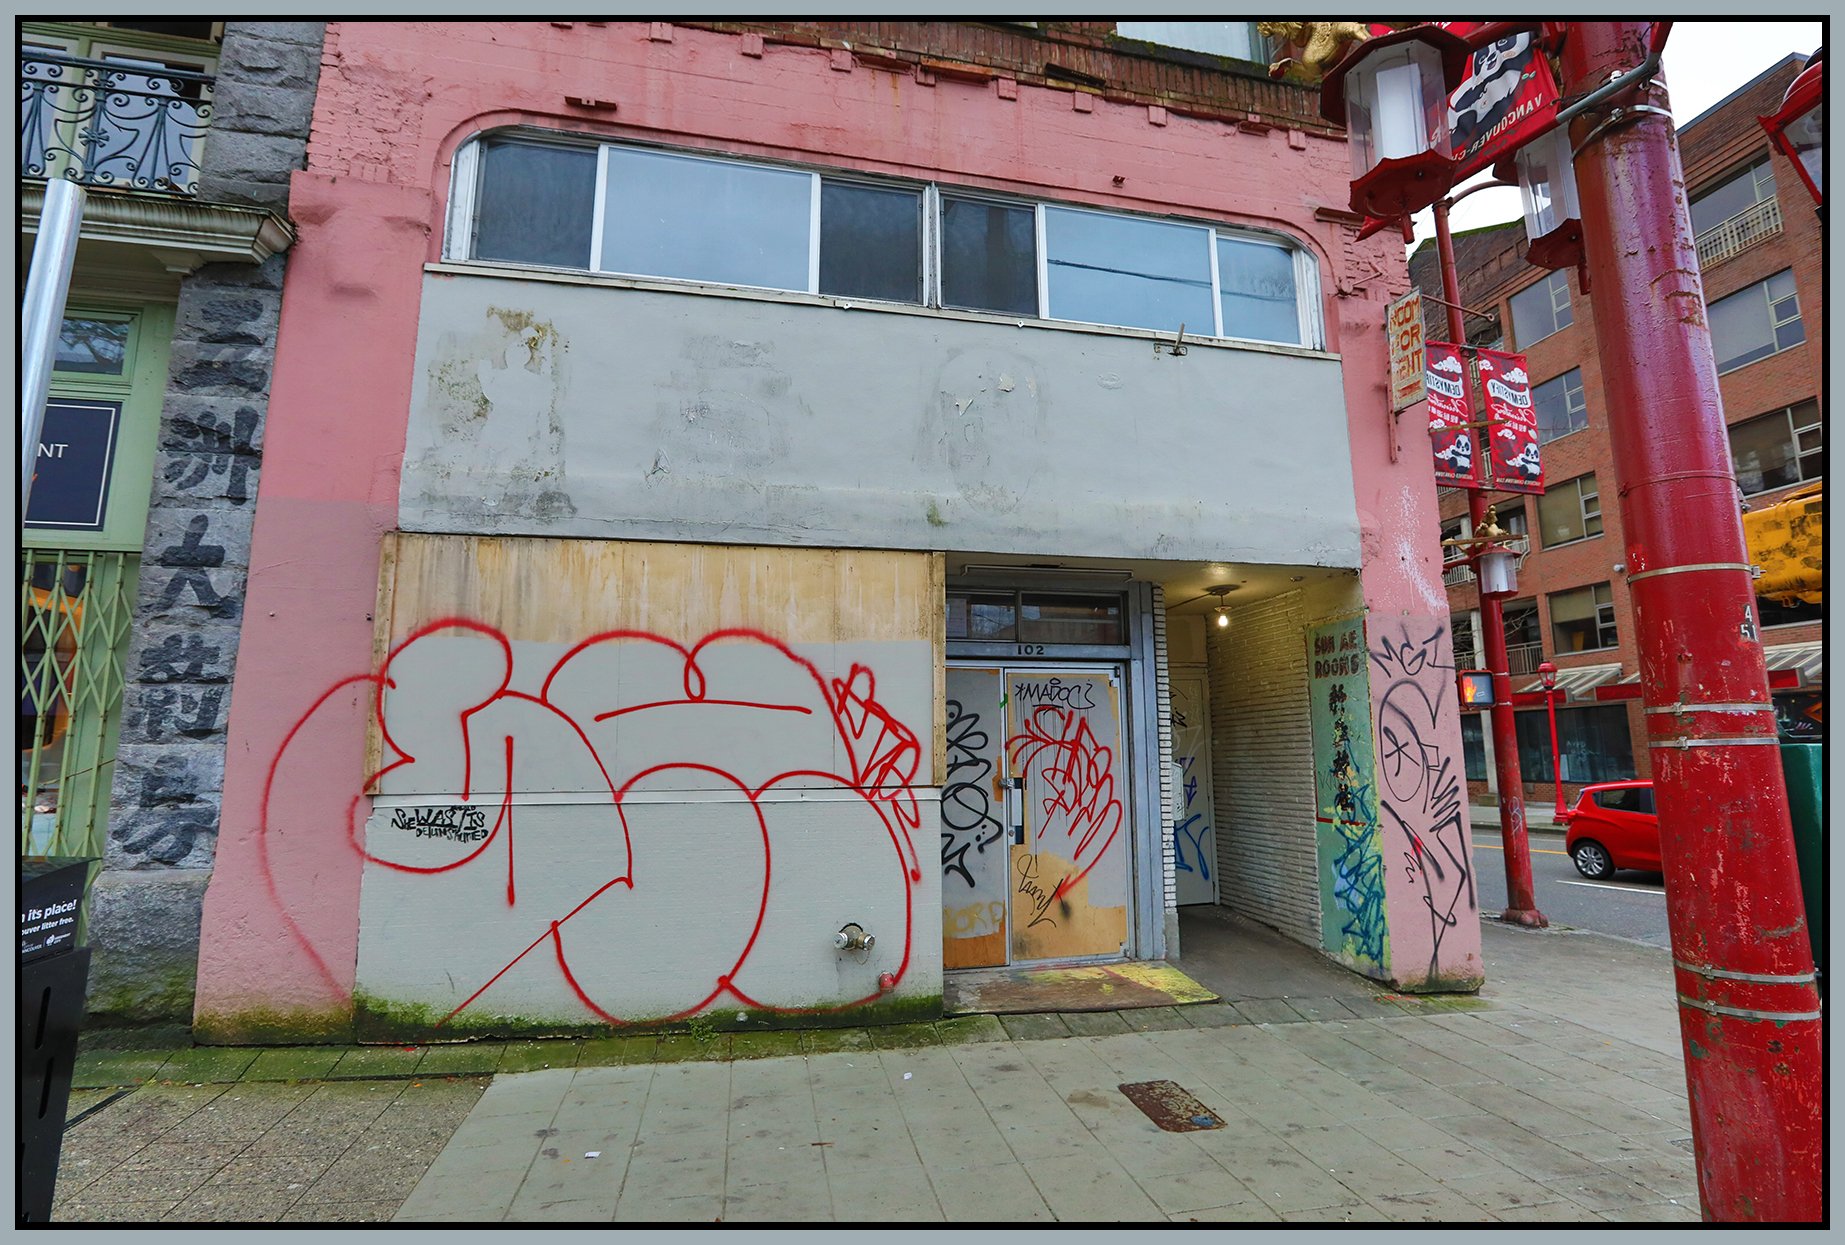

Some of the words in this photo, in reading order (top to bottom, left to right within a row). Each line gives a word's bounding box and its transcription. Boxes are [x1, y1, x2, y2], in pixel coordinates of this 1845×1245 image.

[38, 443, 69, 458] NT
[1017, 644, 1045, 656] 102
[27, 909, 43, 922] its
[43, 899, 77, 919] place!
[41, 920, 59, 930] litter
